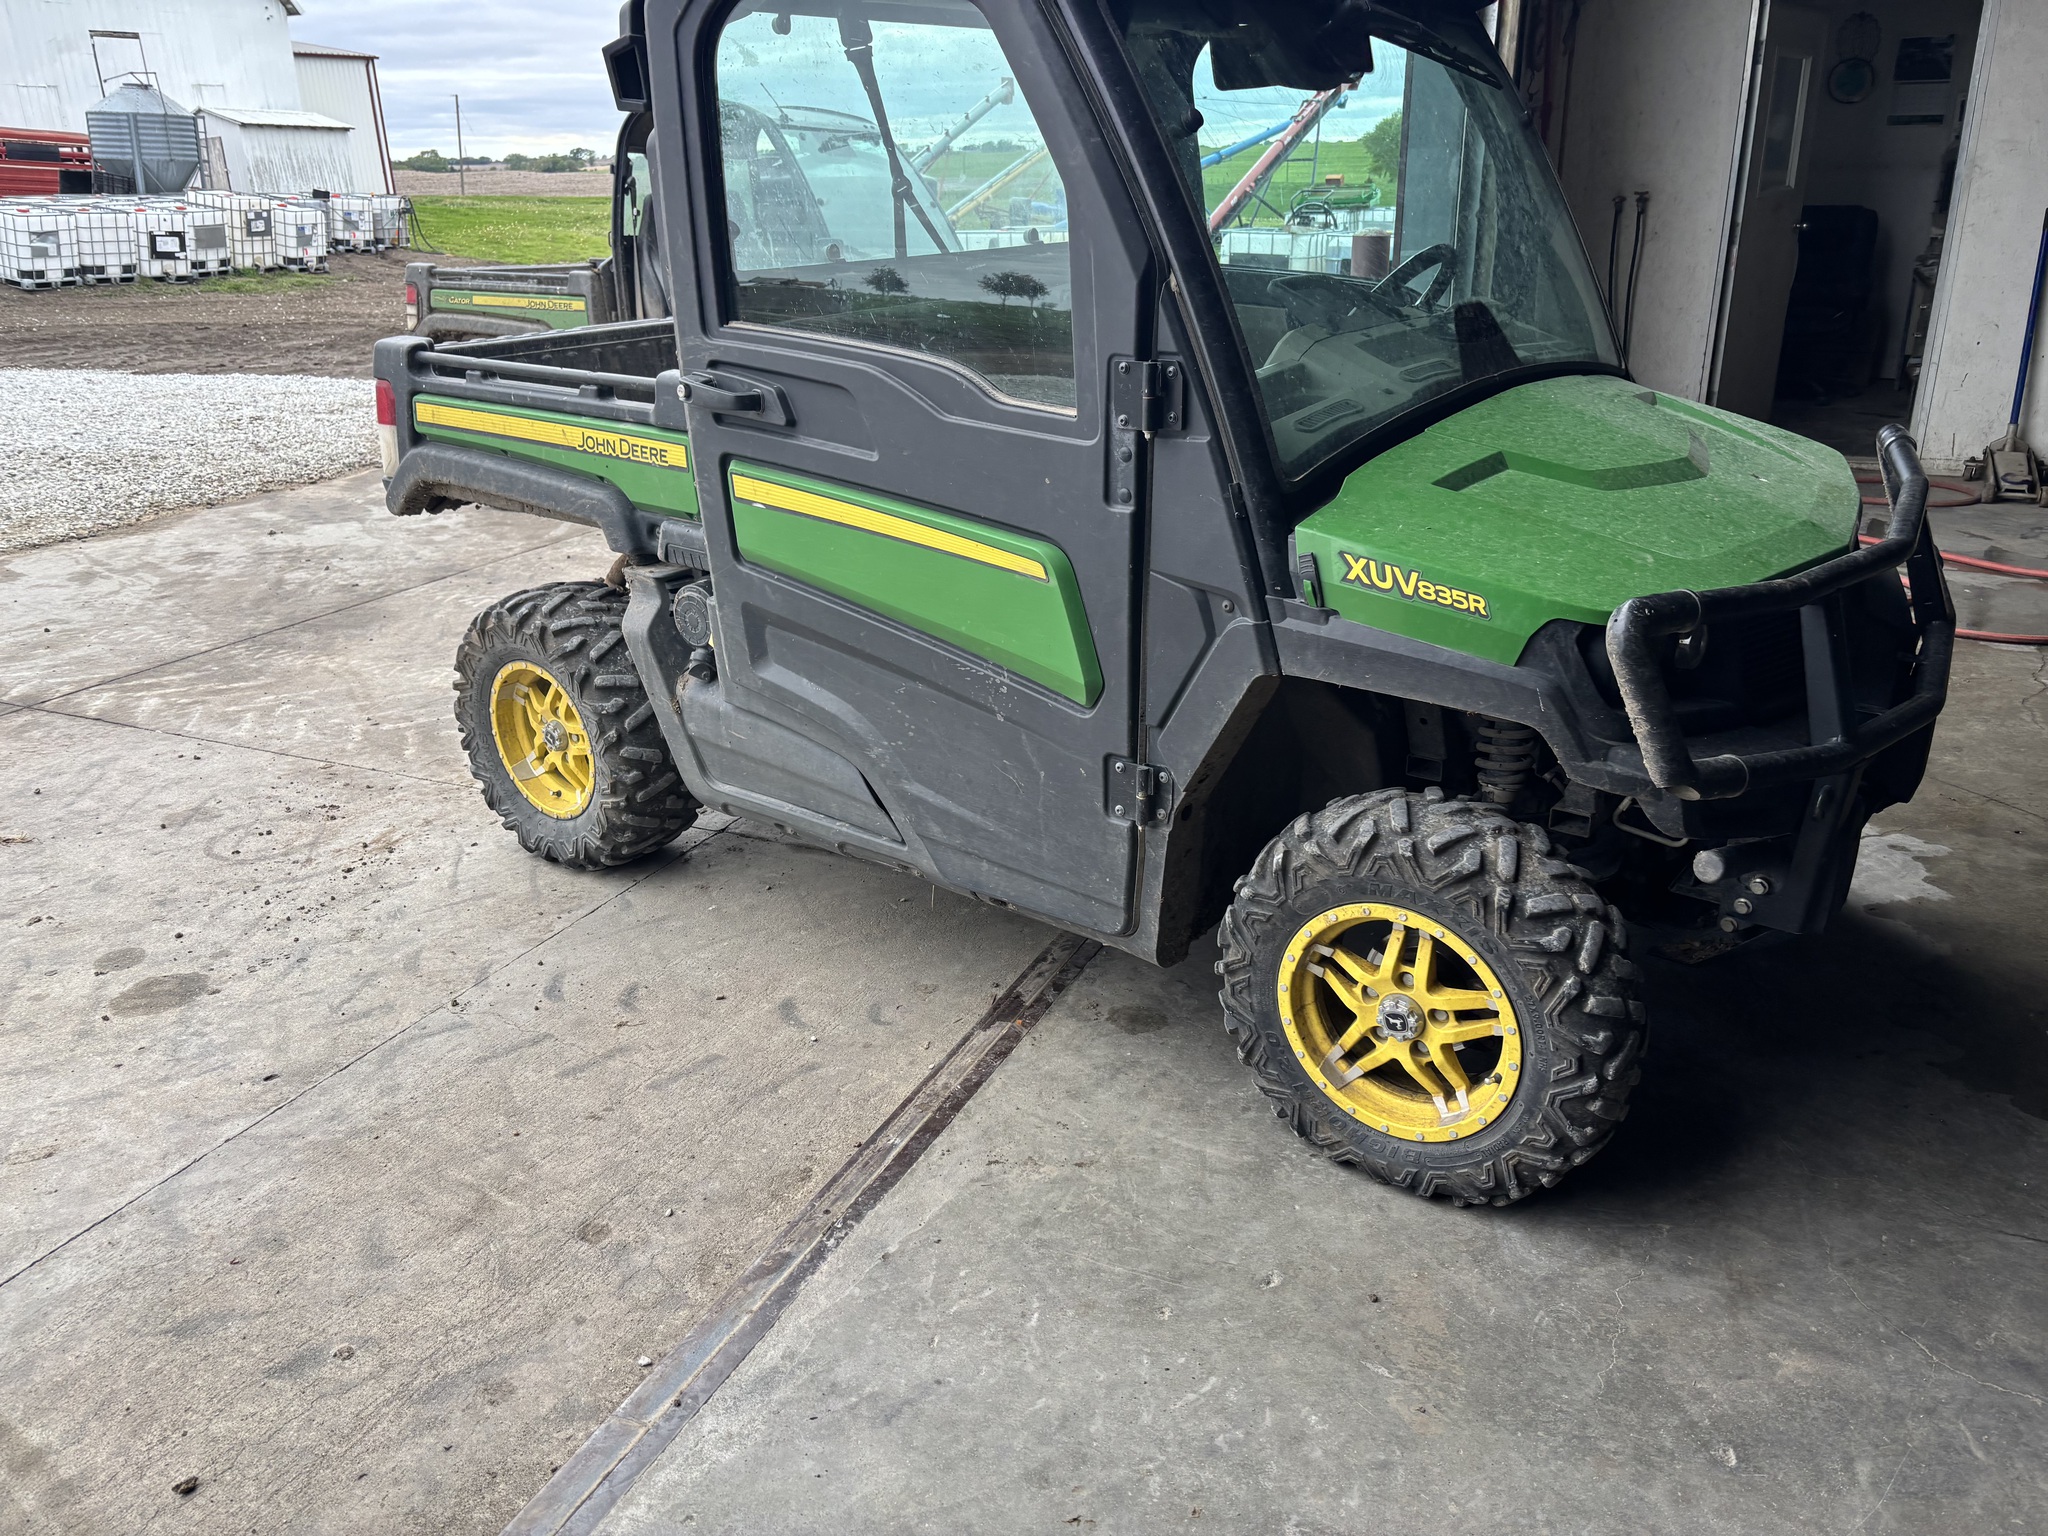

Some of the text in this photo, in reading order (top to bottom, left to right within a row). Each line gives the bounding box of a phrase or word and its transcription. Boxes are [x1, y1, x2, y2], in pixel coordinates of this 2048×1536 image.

[448, 295, 471, 305] GATOR
[525, 298, 574, 311] JOHN DEERE
[577, 431, 669, 464] JOHN DEERE
[1367, 881, 1500, 955] MAXXIS
[1292, 1082, 1422, 1165] BIGHORN
[1480, 1137, 1510, 1158] RADIAL
